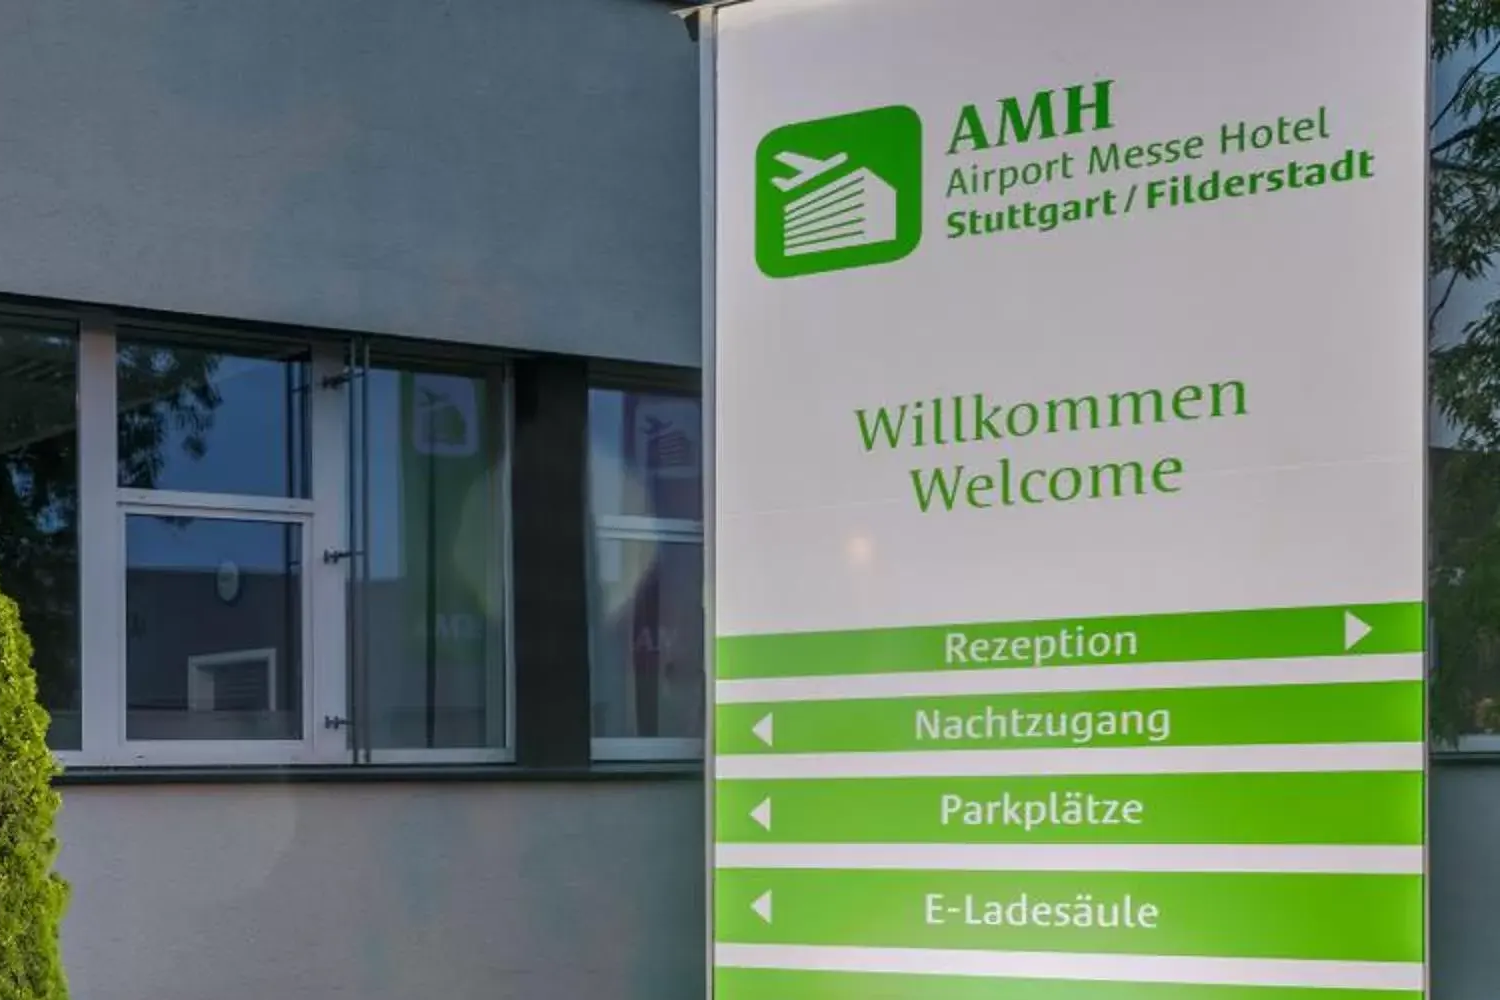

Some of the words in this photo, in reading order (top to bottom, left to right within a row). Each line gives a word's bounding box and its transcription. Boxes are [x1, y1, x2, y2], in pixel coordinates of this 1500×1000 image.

[946, 79, 1115, 154] AMH
[947, 154, 1073, 198] Airport
[1088, 135, 1204, 175] Messe
[1220, 106, 1329, 154] Hotel
[946, 189, 1116, 238] Stuttgart
[1146, 149, 1375, 209] Filderstadt
[854, 378, 1248, 451] Willkommen
[909, 456, 1185, 513] Welcome
[946, 625, 1136, 666] Rezeption
[915, 706, 1171, 743] Nachtzugang
[941, 792, 1144, 832] Parkplätze
[926, 893, 1159, 928] E-Ladesäule
